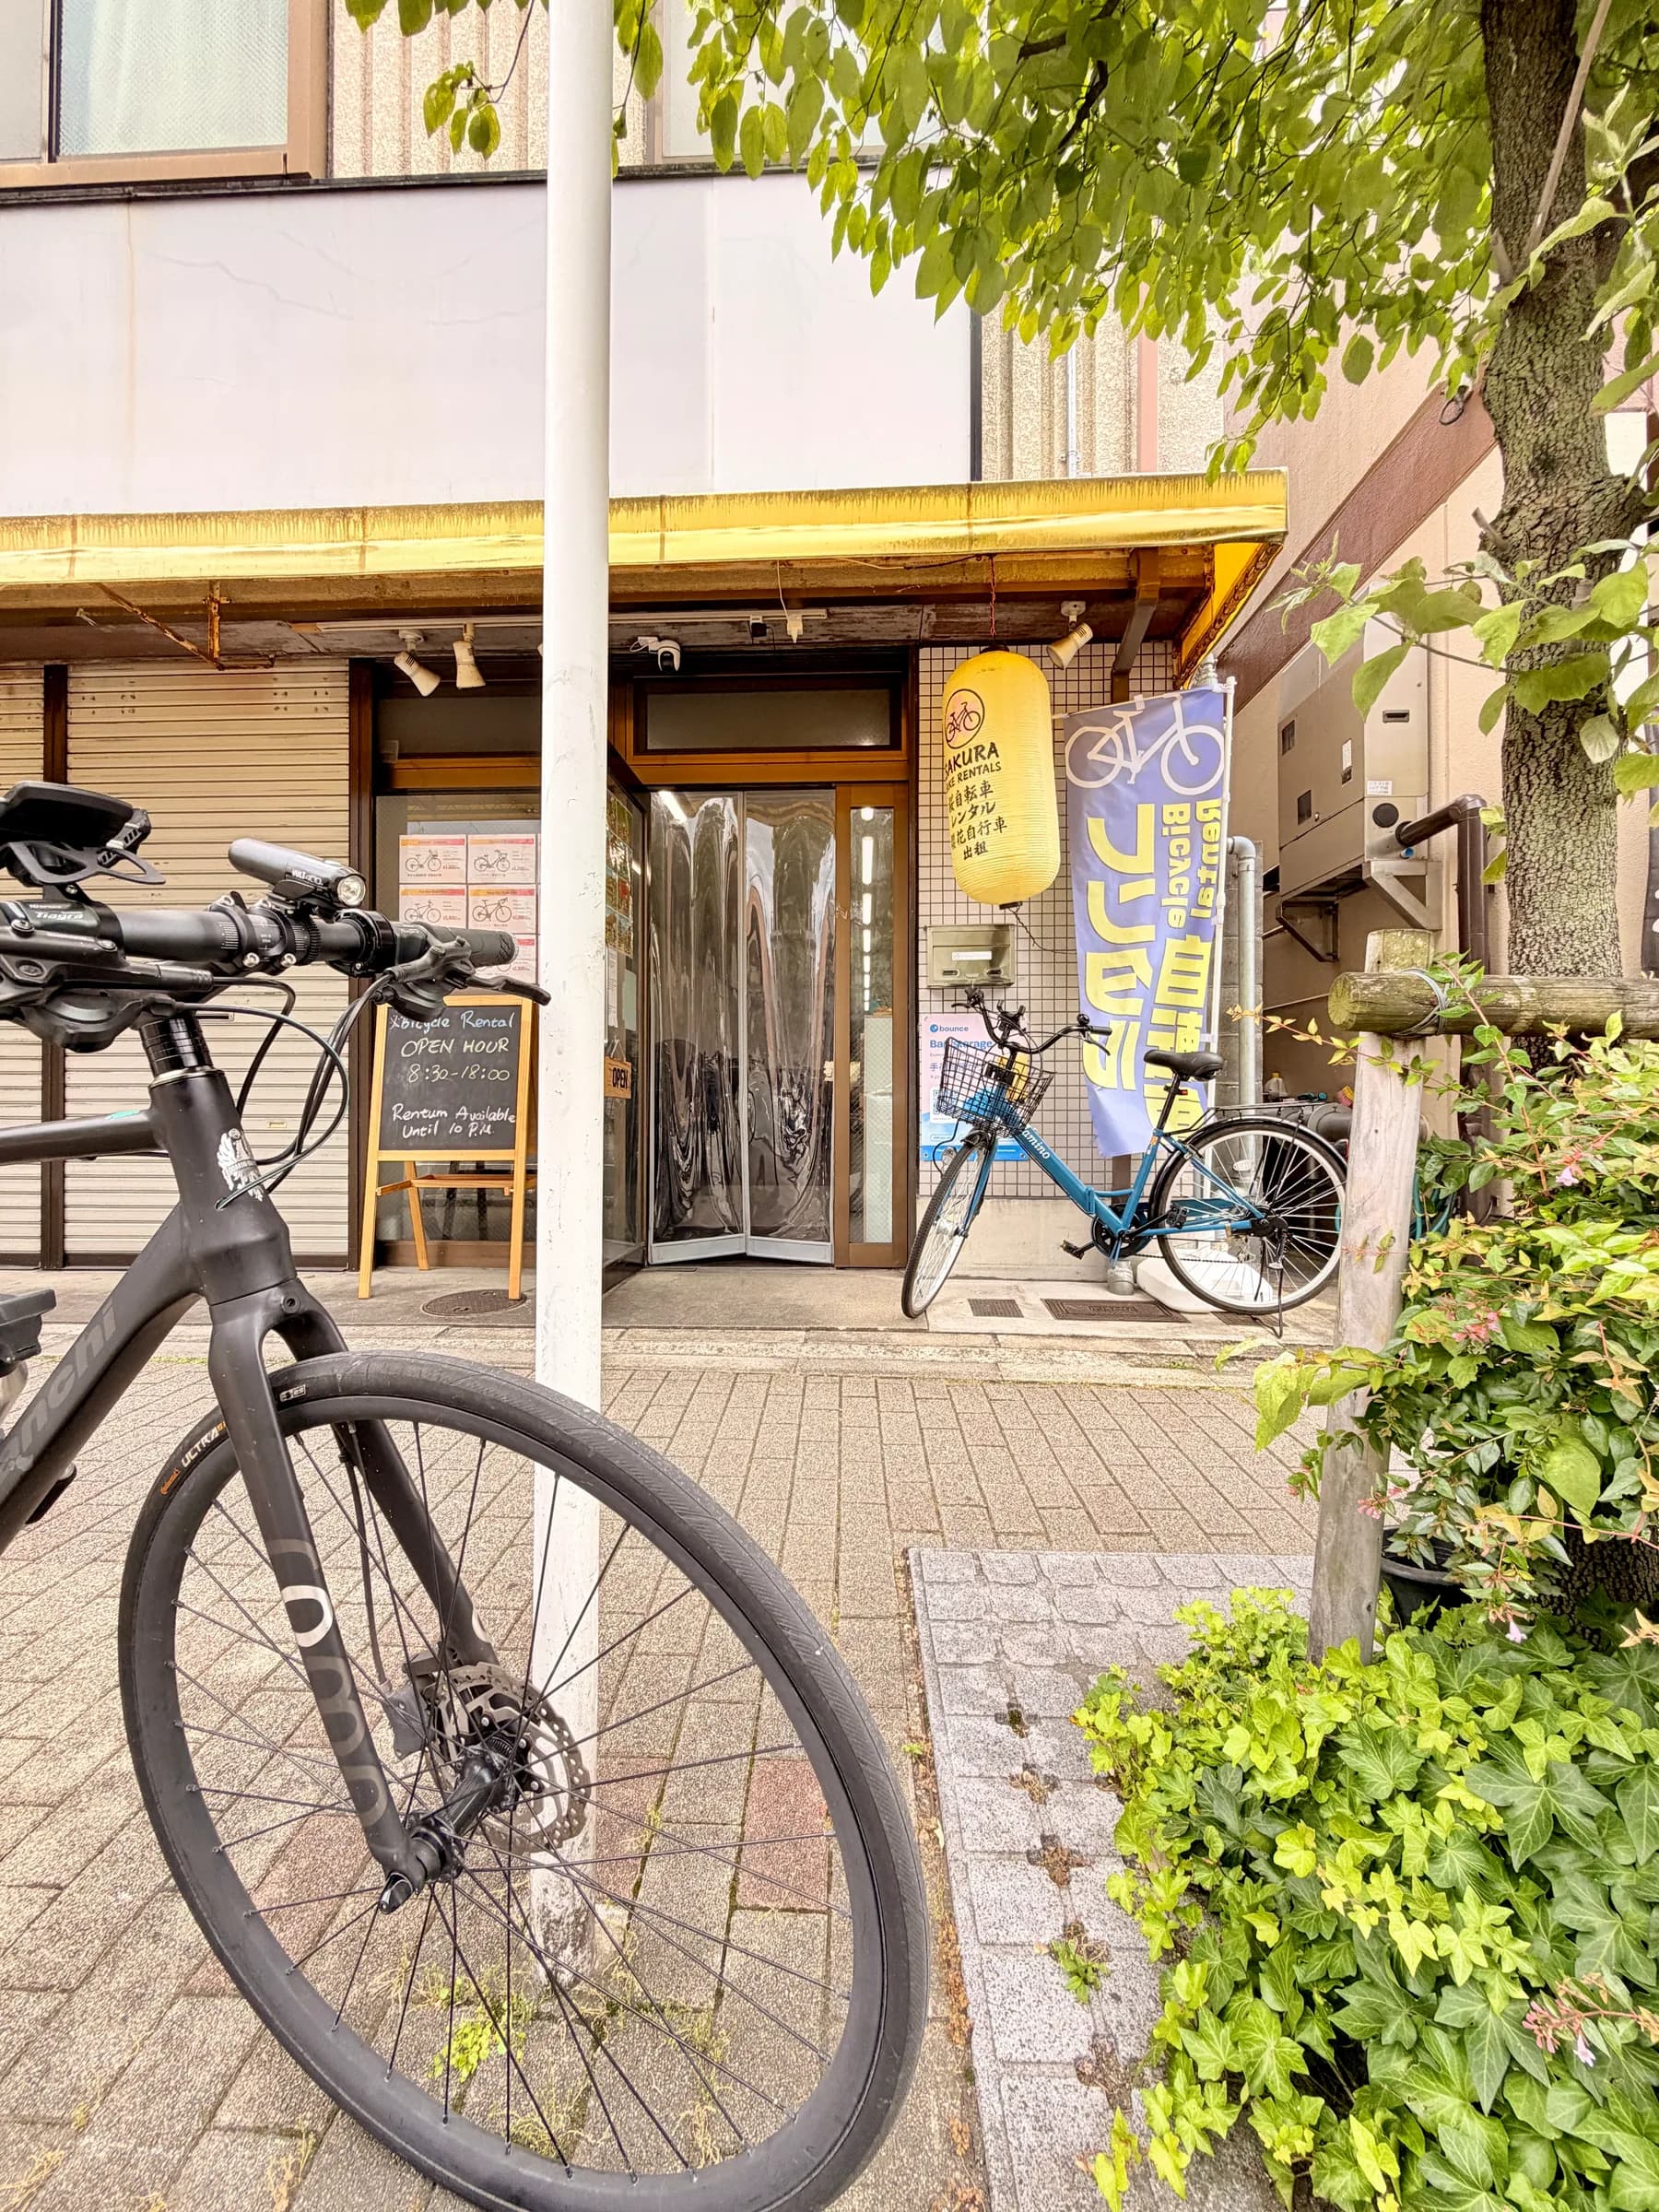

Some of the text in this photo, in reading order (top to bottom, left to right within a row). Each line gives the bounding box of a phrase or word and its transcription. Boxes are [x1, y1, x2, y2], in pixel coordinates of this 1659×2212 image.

[957, 761, 1002, 783] RENTALS
[951, 801, 996, 829] レンタル
[963, 841, 988, 860] 出租
[460, 1010, 515, 1030] Rental
[939, 1024, 969, 1032] bounce
[401, 1037, 510, 1057] OPEN HOUR
[929, 1040, 948, 1050] Ba
[612, 1066, 629, 1088] OPEN
[455, 1106, 516, 1123] Available
[402, 1121, 440, 1138] Until
[449, 1123, 463, 1135] 10
